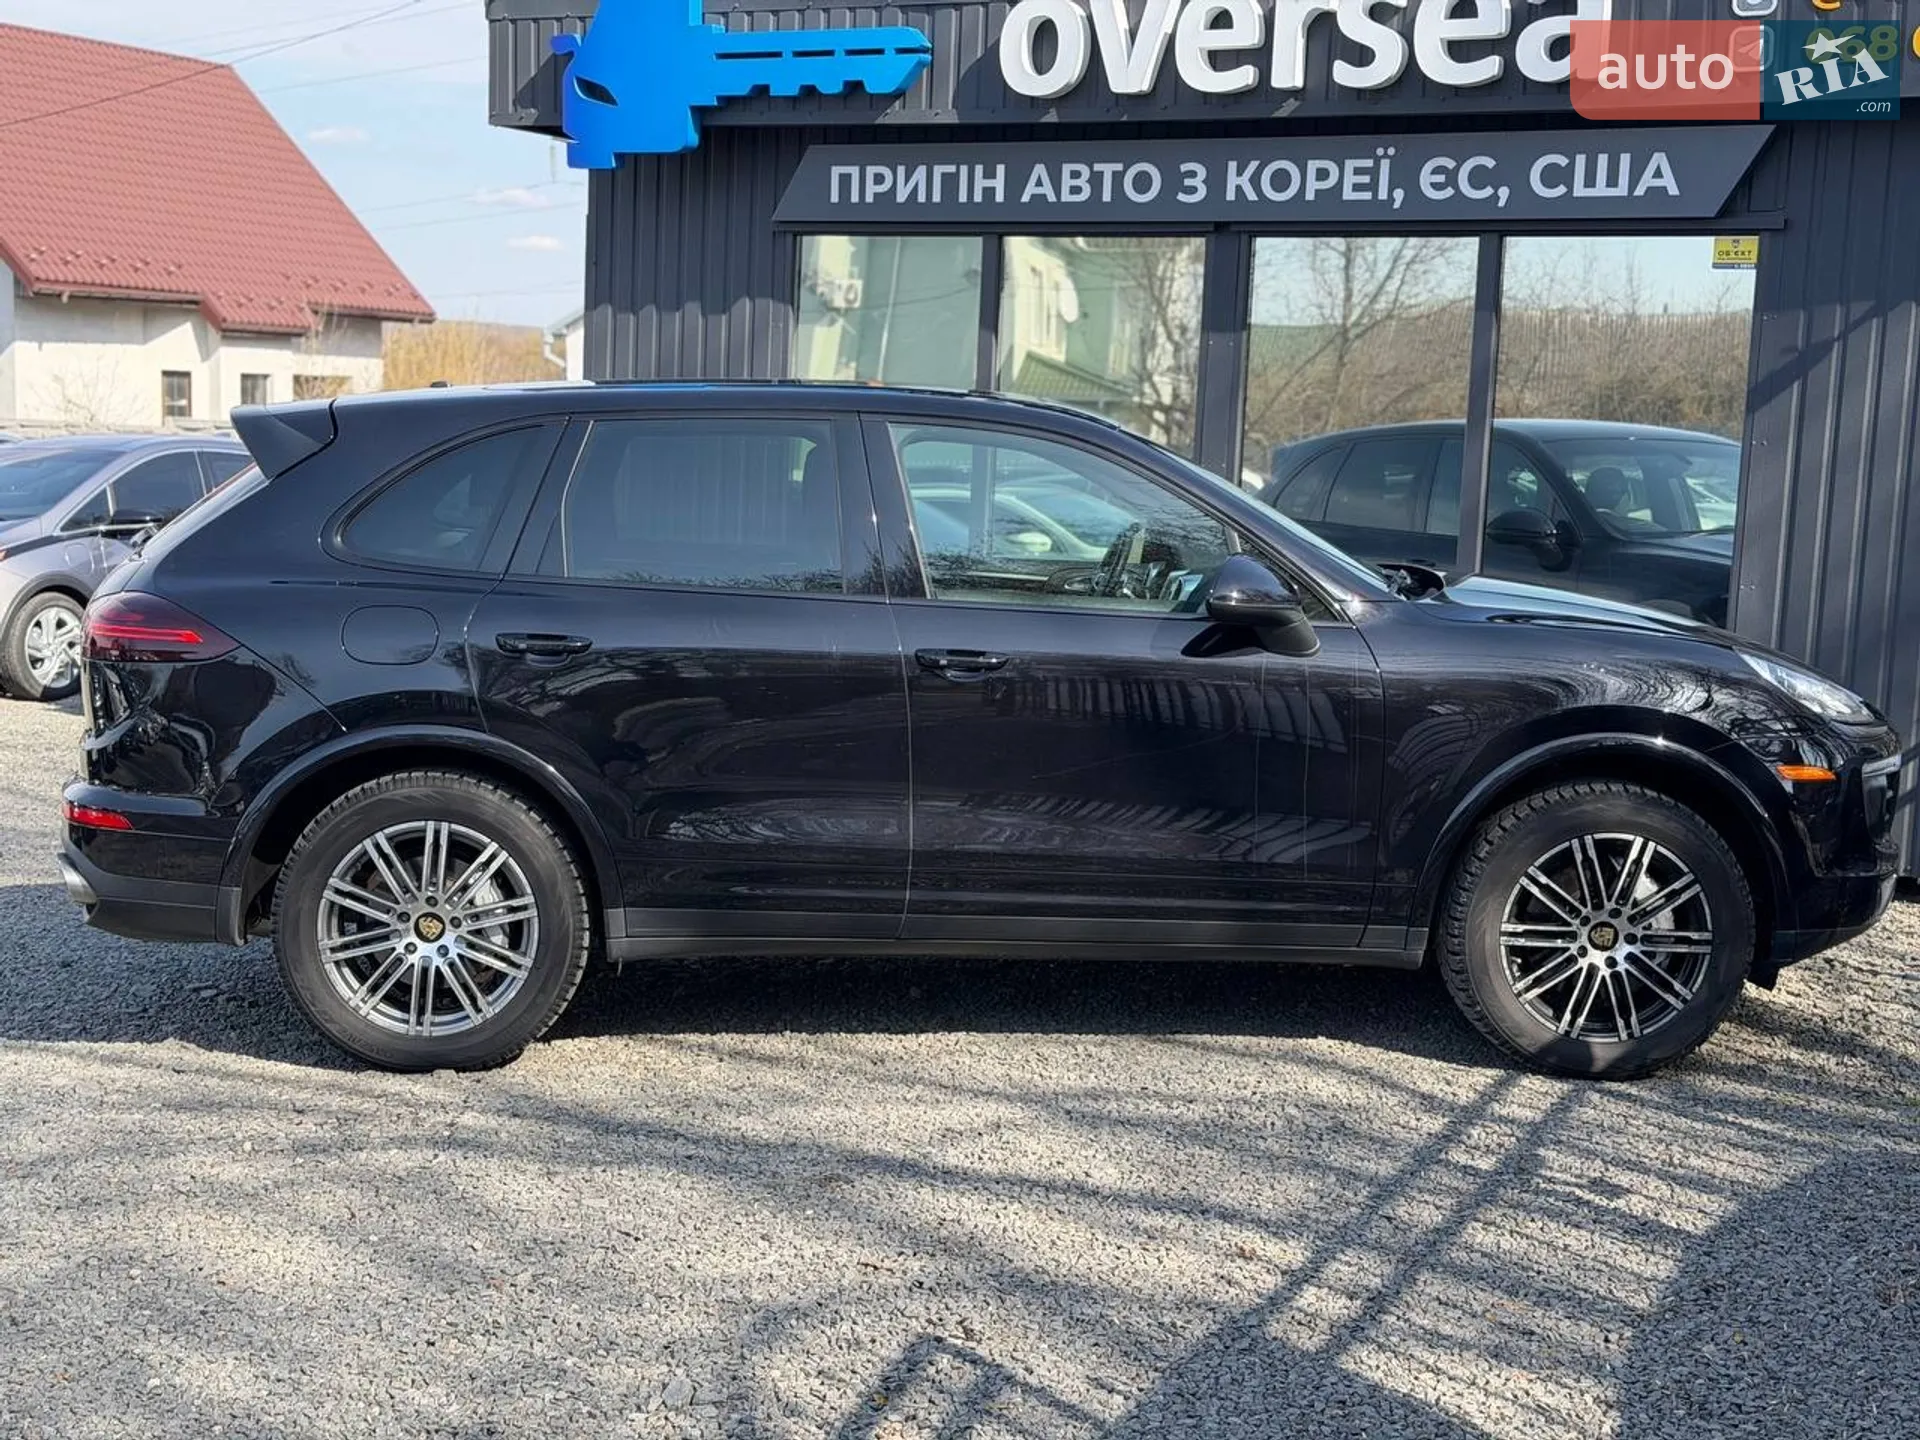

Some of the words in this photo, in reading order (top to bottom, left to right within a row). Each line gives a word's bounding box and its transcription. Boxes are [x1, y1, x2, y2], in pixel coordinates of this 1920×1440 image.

[999, 0, 1611, 97] oversea
[829, 163, 1006, 204] ПРИГІН
[1020, 161, 1162, 204] АВТО
[1175, 161, 1208, 204] З
[1225, 147, 1405, 210] КОРЕЇ,
[1419, 155, 1510, 208] ЄС,
[1529, 151, 1681, 199] США
